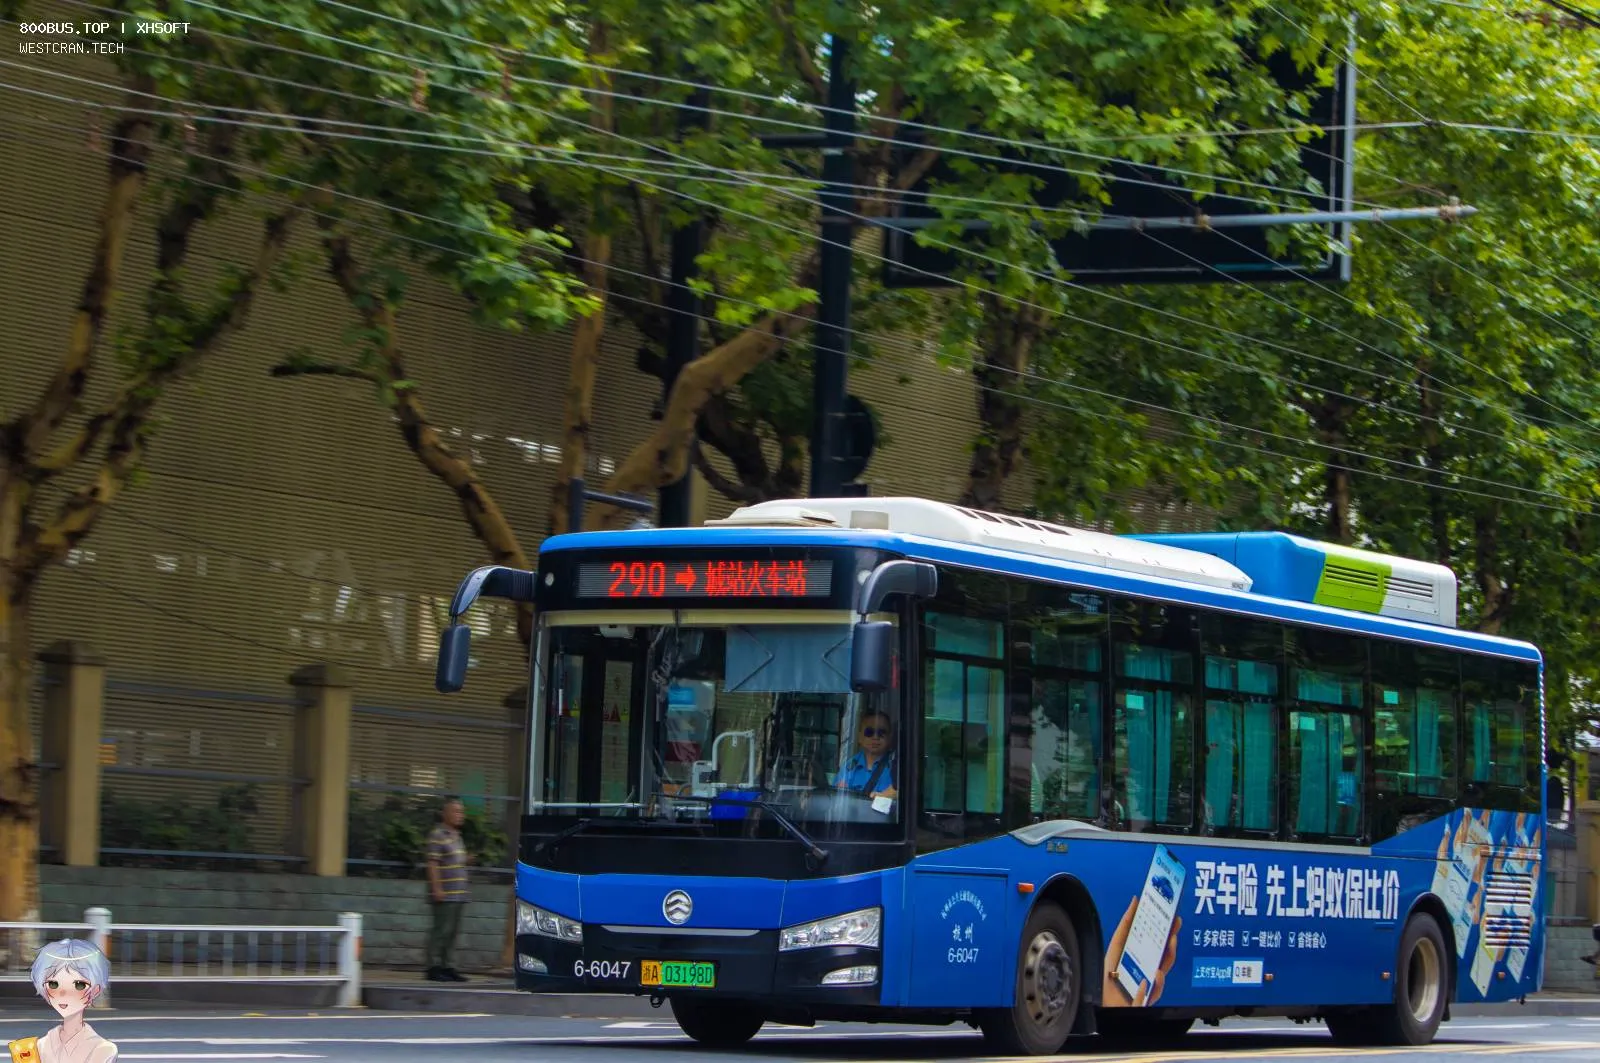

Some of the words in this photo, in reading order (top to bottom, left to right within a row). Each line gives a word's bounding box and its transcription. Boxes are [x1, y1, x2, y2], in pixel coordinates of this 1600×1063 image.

[607, 562, 666, 597] 290
[1194, 861, 1258, 916] 买车险
[1266, 864, 1400, 920] 先上蚂蚁保比价
[952, 922, 974, 944] 杭州
[1203, 930, 1235, 948] 多家保司
[947, 947, 979, 963] 6-6047
[574, 959, 631, 979] 6-6047
